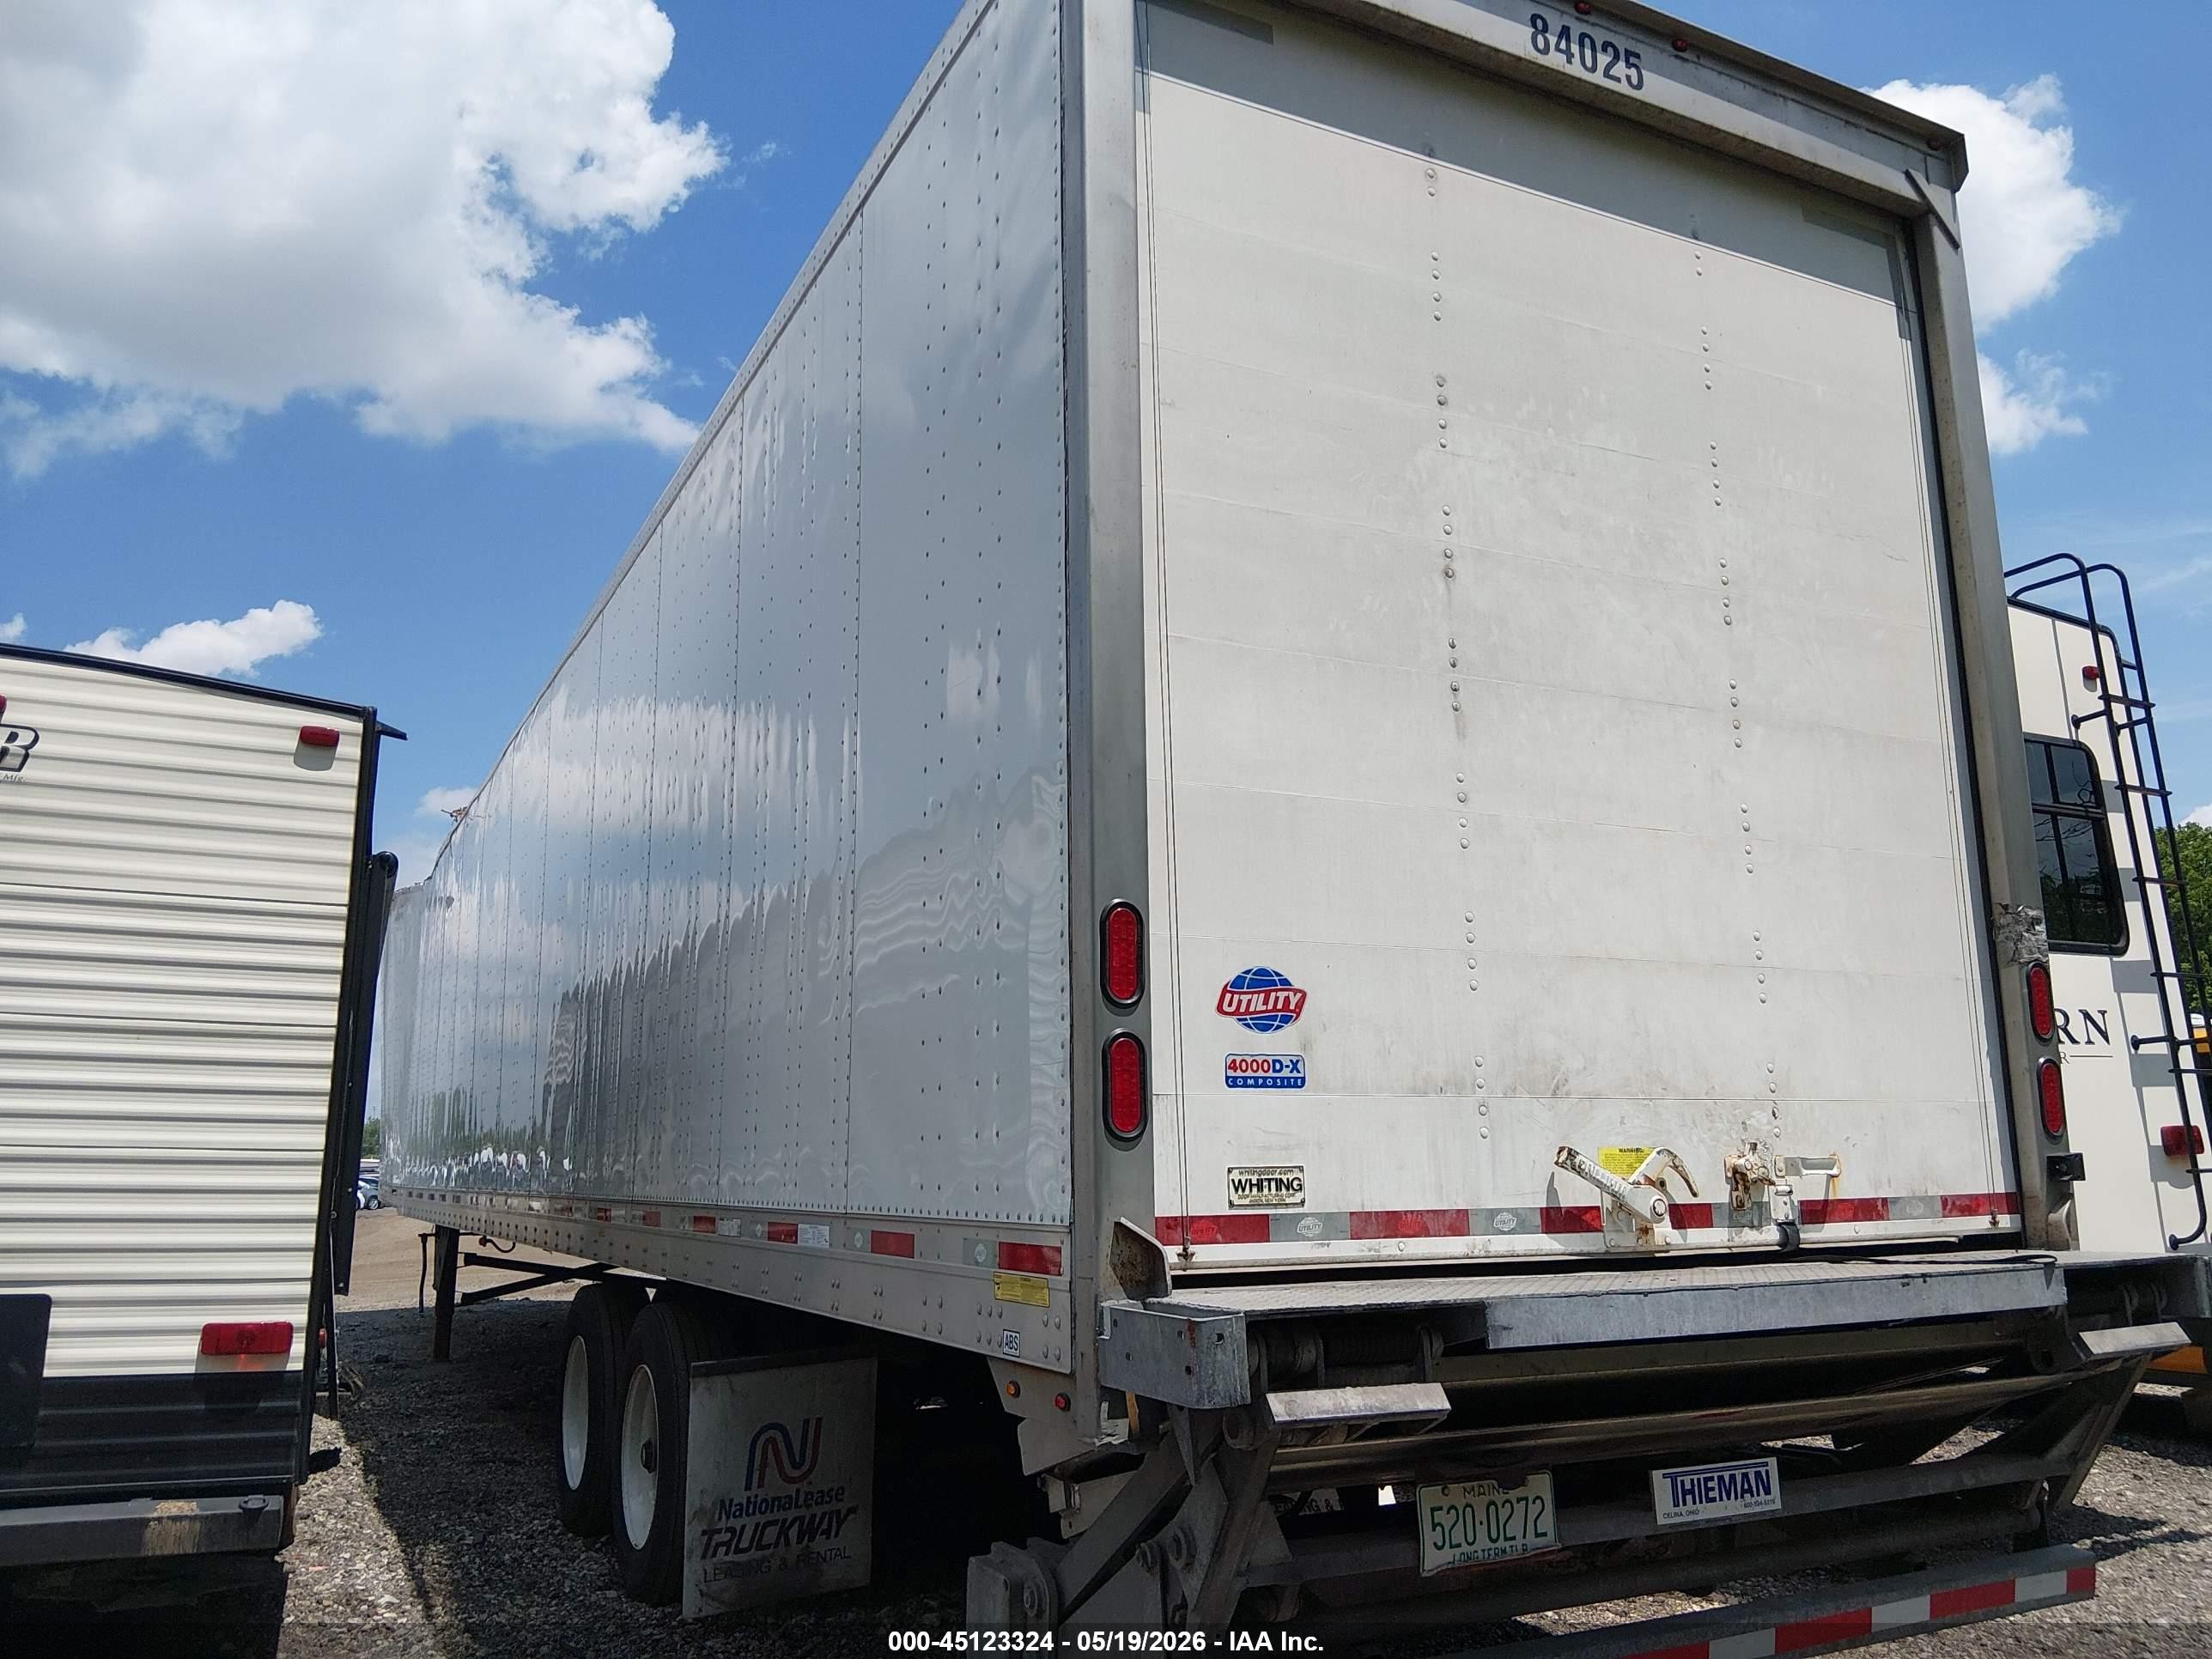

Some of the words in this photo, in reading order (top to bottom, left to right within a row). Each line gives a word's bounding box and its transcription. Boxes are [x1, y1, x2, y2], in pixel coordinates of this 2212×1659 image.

[1529, 13, 1644, 91] 84025
[1222, 991, 1302, 1012] UTILITY
[1228, 1059, 1301, 1073] 4000D-X
[1228, 1076, 1303, 1086] COMPOSITE
[1231, 1177, 1303, 1194] WHITING
[1298, 1223, 1322, 1232] UTILITY
[1004, 1334, 1018, 1352] ABS
[1462, 1482, 1510, 1500] MAIN
[1662, 1462, 1772, 1508] THIEMAN
[717, 1486, 846, 1522] NationaLease
[700, 1504, 859, 1560] TRUCKWAY
[703, 1559, 771, 1583] LEASING
[779, 1557, 789, 1571] &
[797, 1547, 853, 1567] RENTAL
